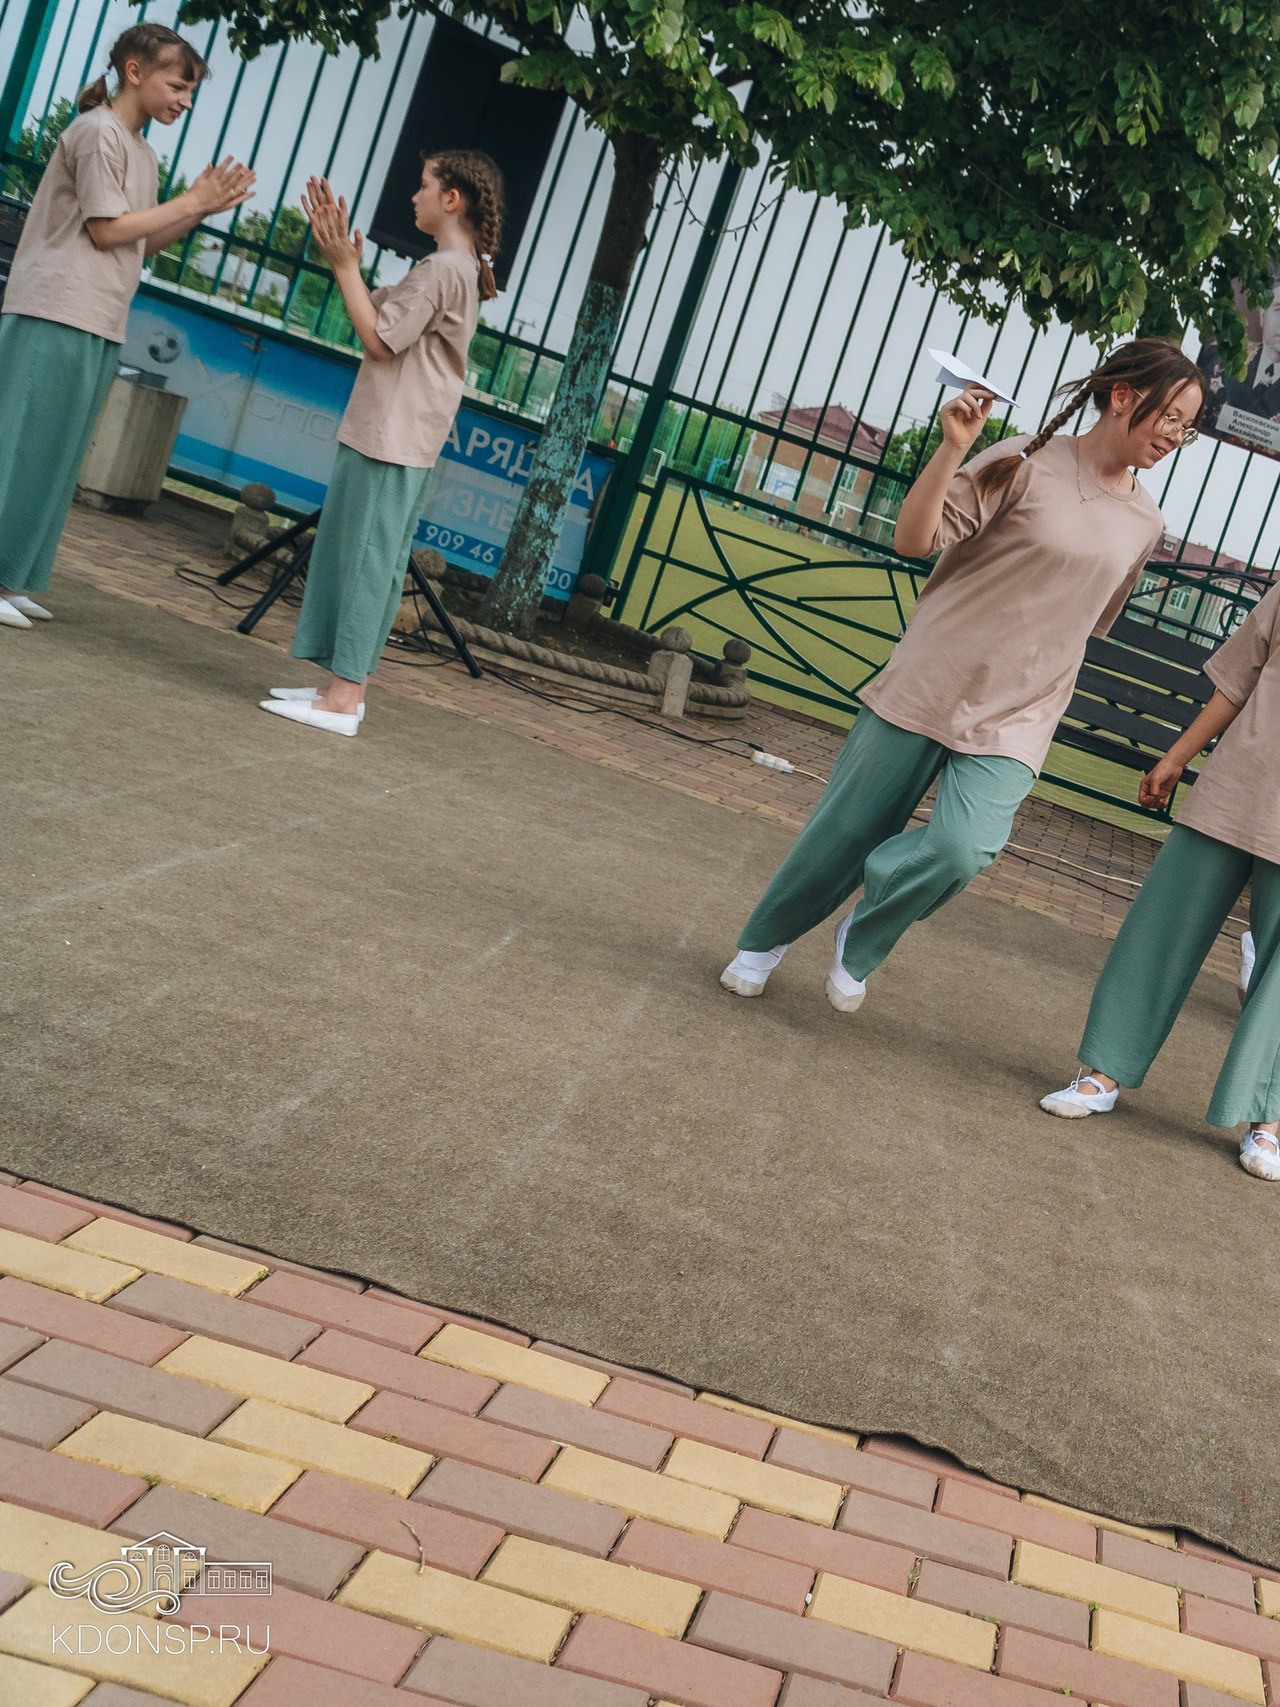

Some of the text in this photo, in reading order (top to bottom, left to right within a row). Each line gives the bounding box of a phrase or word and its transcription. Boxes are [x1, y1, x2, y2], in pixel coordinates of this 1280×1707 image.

[1232, 419, 1272, 437] Александр
[446, 419, 594, 501] АРЯДА
[426, 525, 465, 551] 909
[470, 544, 495, 563] 46
